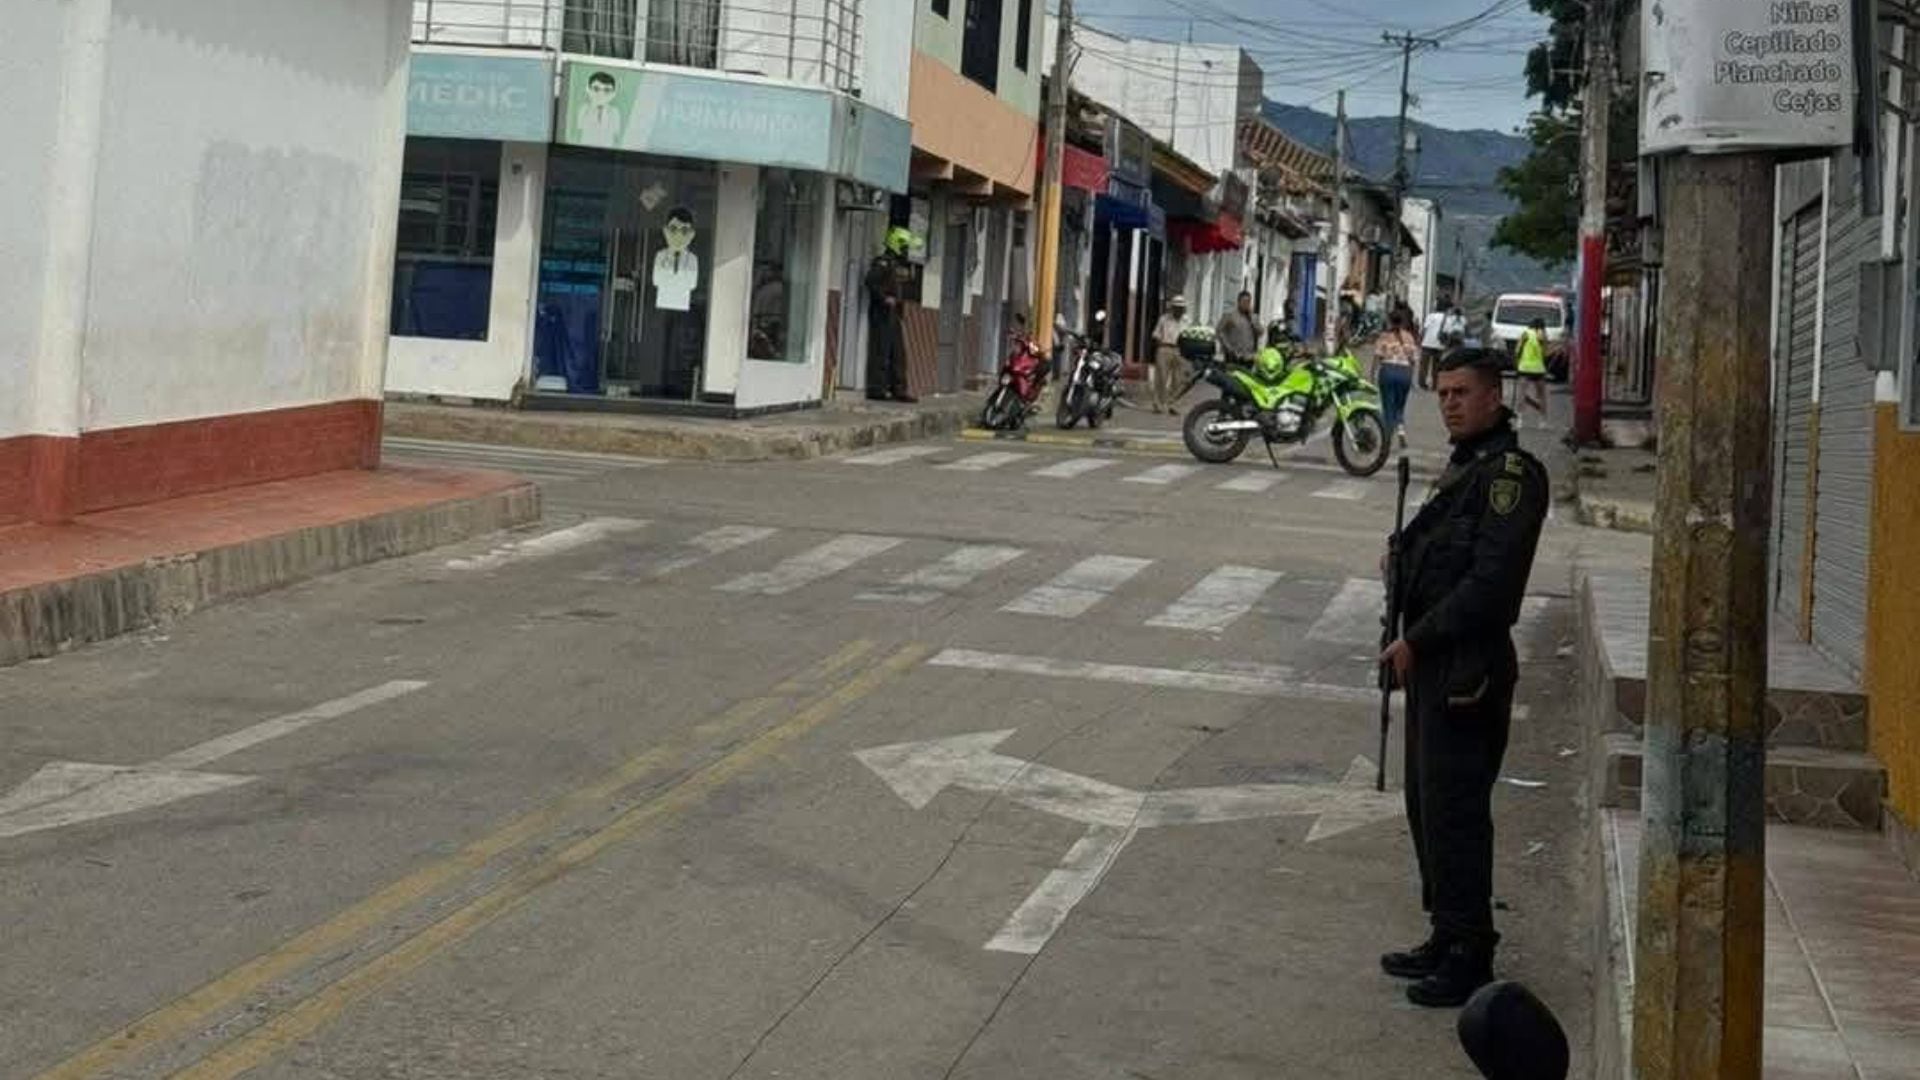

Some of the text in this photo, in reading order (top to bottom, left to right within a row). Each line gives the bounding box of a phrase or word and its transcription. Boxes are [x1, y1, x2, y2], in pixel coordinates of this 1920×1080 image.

[1771, 1, 1840, 24] Niños
[1725, 30, 1841, 57] Cepillado
[1715, 60, 1841, 84] Planchado
[1774, 89, 1842, 116] Cejas
